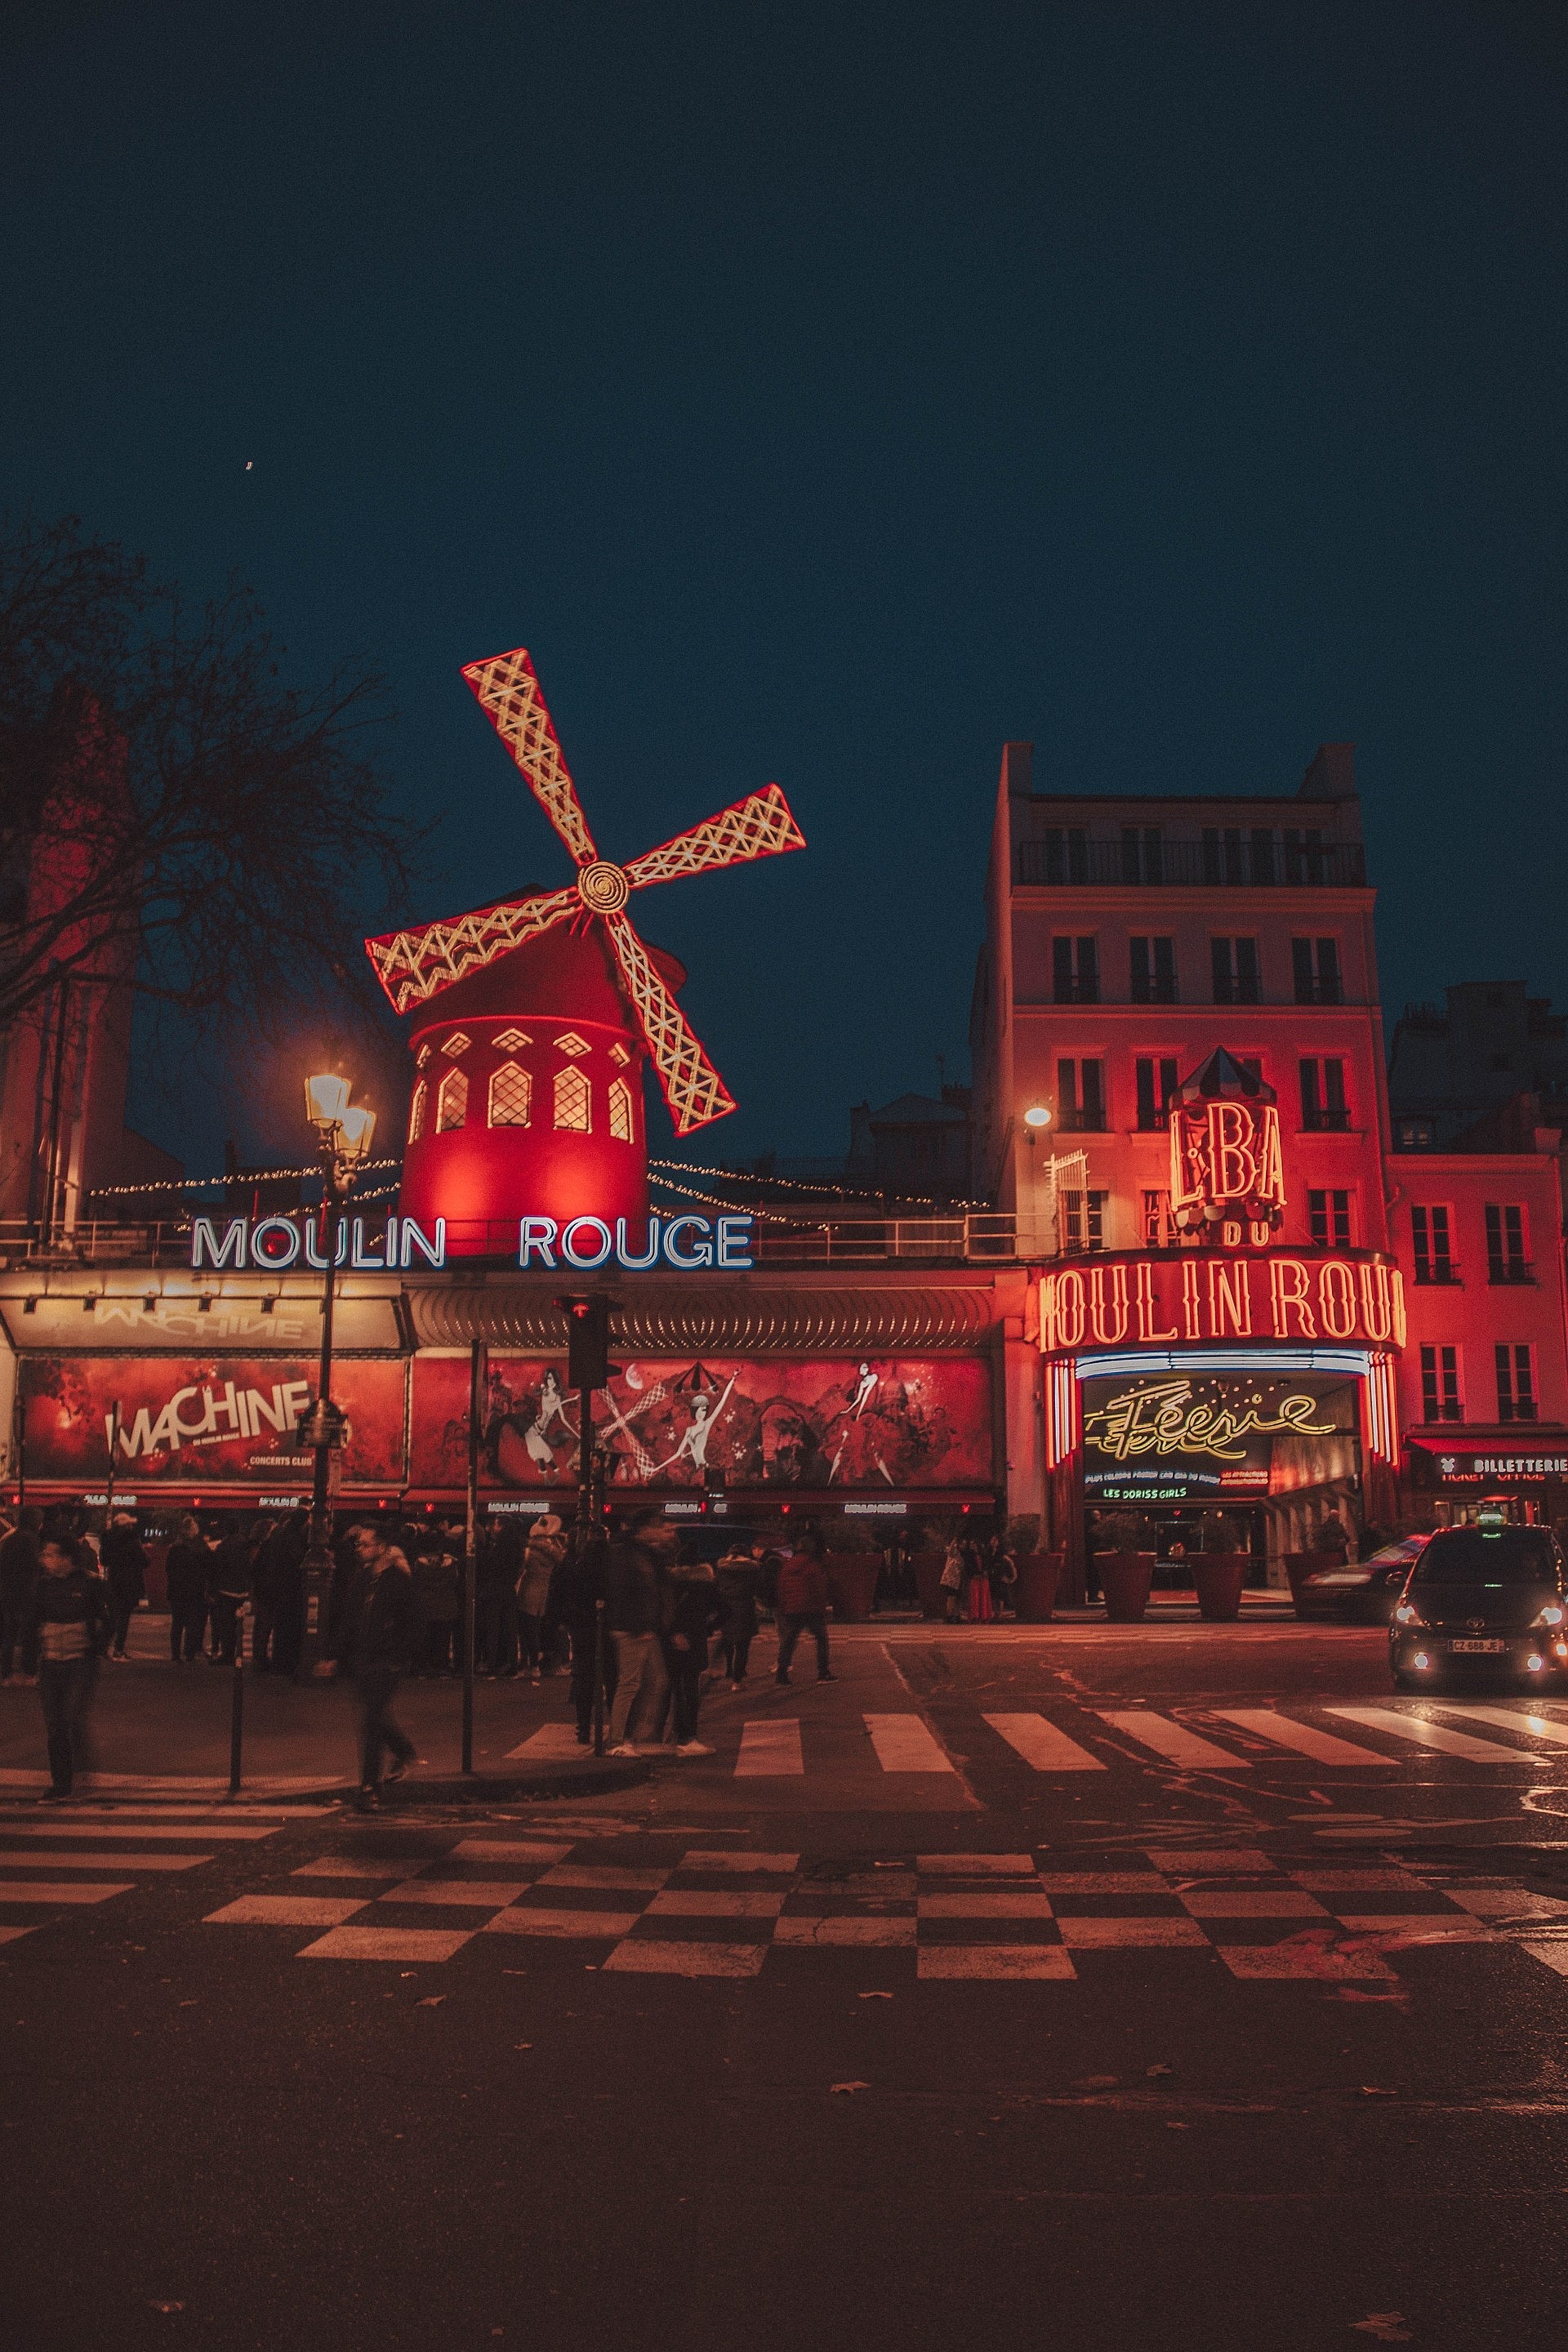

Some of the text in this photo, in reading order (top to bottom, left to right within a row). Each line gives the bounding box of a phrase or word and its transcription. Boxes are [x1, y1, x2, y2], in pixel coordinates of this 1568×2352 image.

[1225, 1221, 1269, 1247] DU
[191, 1215, 755, 1270] MOULIN ROUGE
[249, 1456, 313, 1467] CONCERTS CLUB
[1473, 1459, 1568, 1472] BILLETTERIE
[1103, 1487, 1187, 1499] LES DORISS GIRLS
